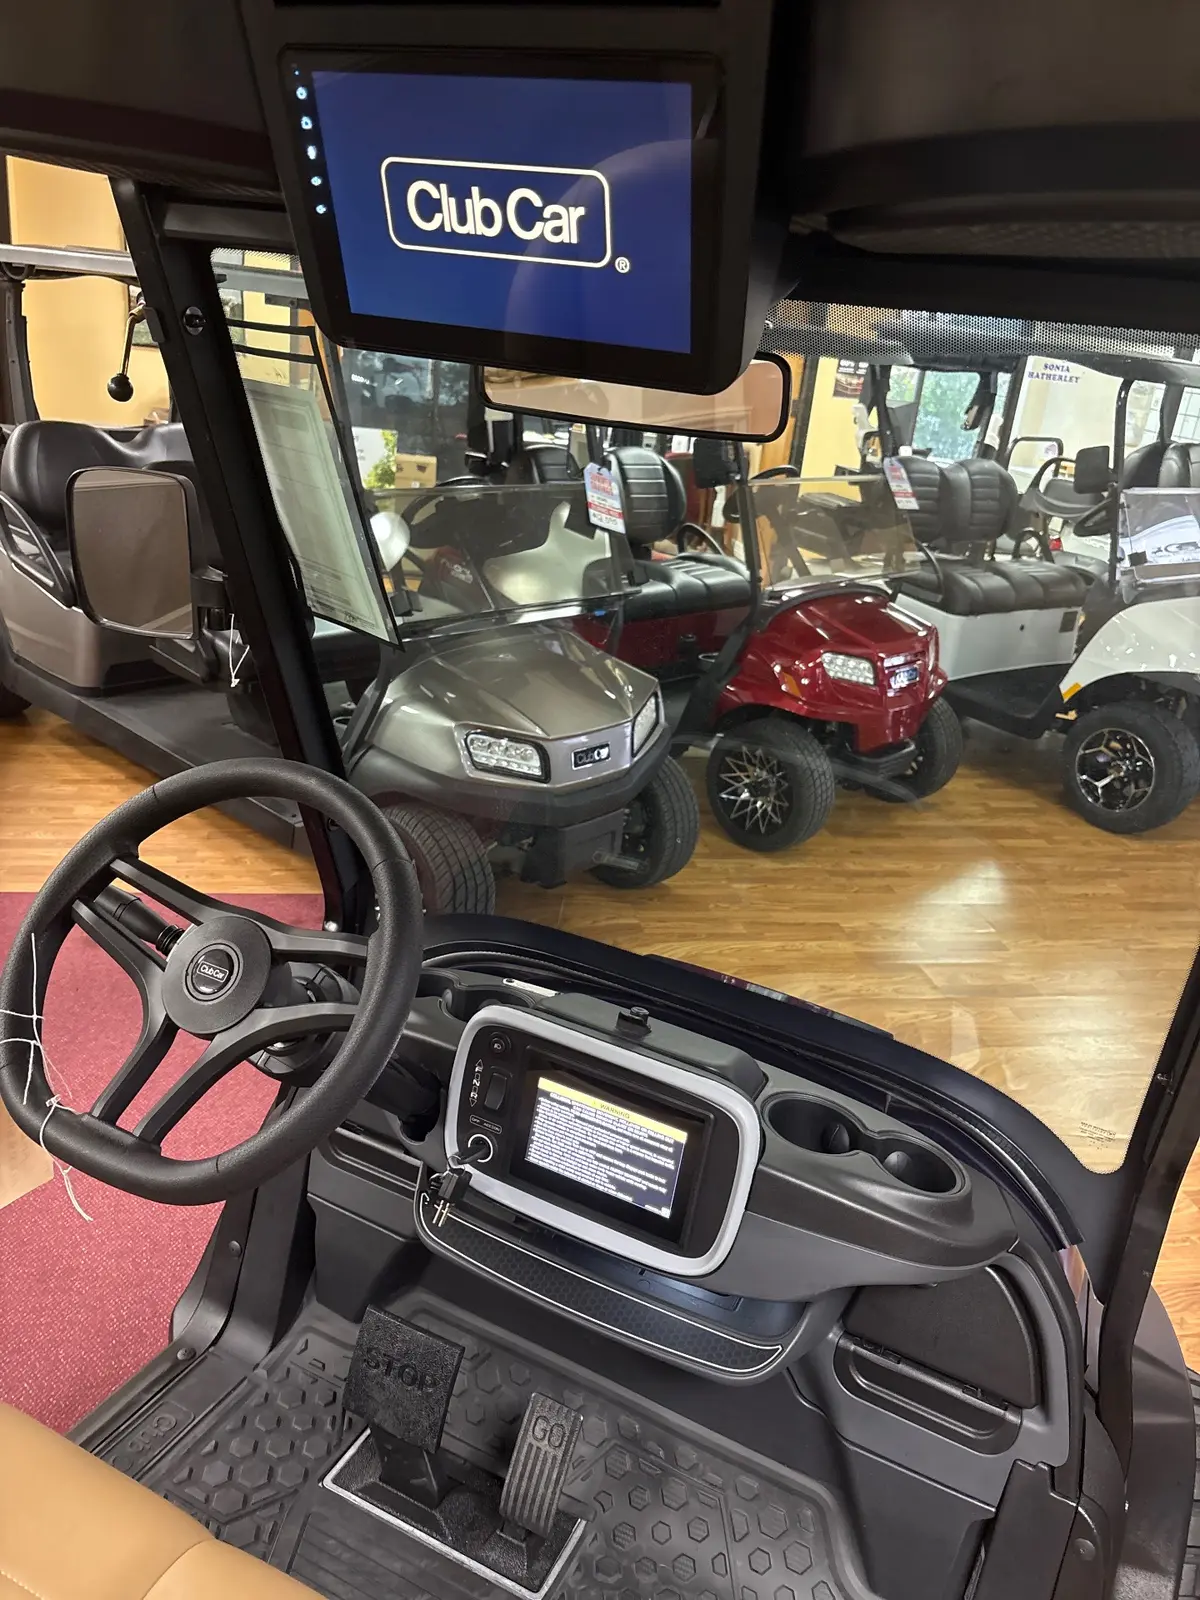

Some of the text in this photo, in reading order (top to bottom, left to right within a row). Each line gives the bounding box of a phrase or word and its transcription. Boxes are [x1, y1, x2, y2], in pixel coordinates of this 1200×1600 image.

[406, 180, 587, 245] Club Car
[1043, 362, 1071, 373] SONIA
[1027, 371, 1081, 384] HATHERLEY
[200, 965, 225, 979] Club Car
[600, 1103, 630, 1119] WARNING
[363, 1347, 441, 1391] STOP
[531, 1414, 566, 1449] GO
